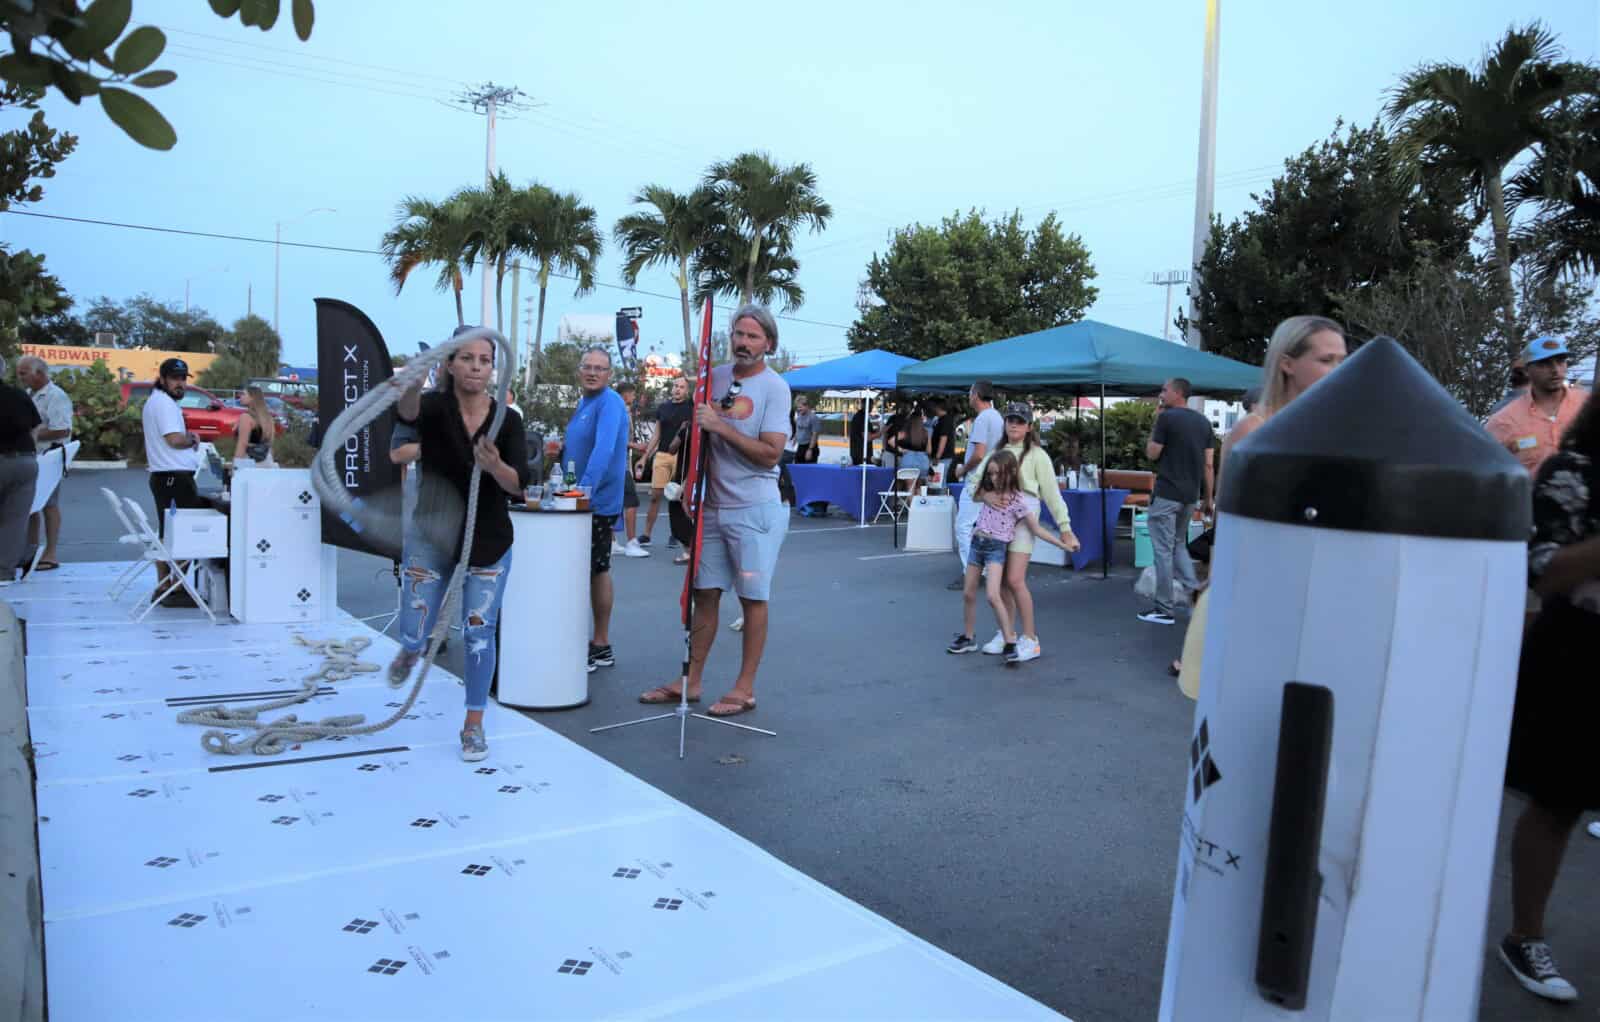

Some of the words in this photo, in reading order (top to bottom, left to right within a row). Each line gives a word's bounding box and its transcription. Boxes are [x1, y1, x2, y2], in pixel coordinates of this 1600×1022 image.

[23, 346, 112, 361] HARDWARE
[344, 344, 358, 363] X
[344, 369, 359, 488] PROCT
